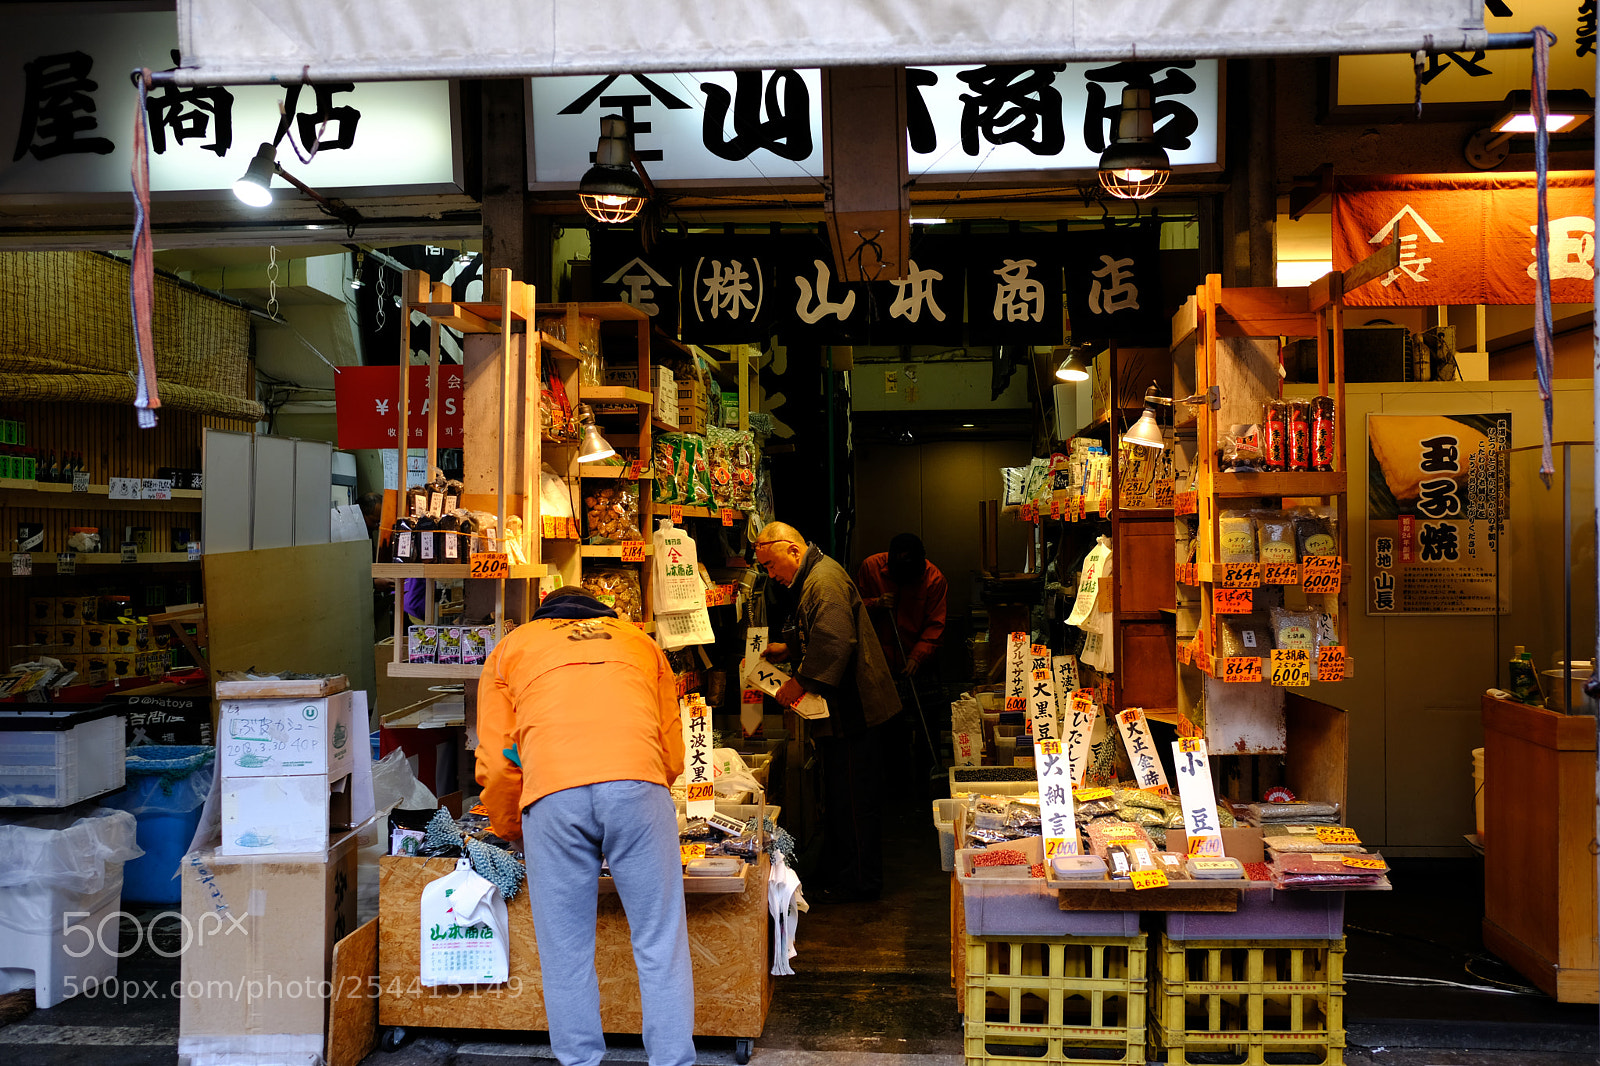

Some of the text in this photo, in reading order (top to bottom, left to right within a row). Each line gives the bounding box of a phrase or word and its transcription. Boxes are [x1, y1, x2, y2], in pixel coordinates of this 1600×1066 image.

[1418, 436, 1461, 562] 玉子焼
[471, 560, 508, 573] 260円
[1305, 556, 1341, 567] ダイエット
[1226, 568, 1260, 580] 864円
[1266, 567, 1297, 578] 864円
[1304, 575, 1339, 588] 600円
[1215, 590, 1253, 603] そばの実
[1374, 572, 1395, 610] 山長
[1011, 641, 1027, 697] ダルマササギ
[1226, 662, 1262, 675] 864円
[1273, 668, 1309, 681] 600円
[1032, 682, 1055, 742] 大黒豆
[689, 716, 708, 783] 丹波大黒
[1126, 721, 1160, 786] 大正金時
[1043, 754, 1067, 837] 大納言
[1180, 751, 1214, 835] 小豆
[430, 922, 494, 941] 山本商店
